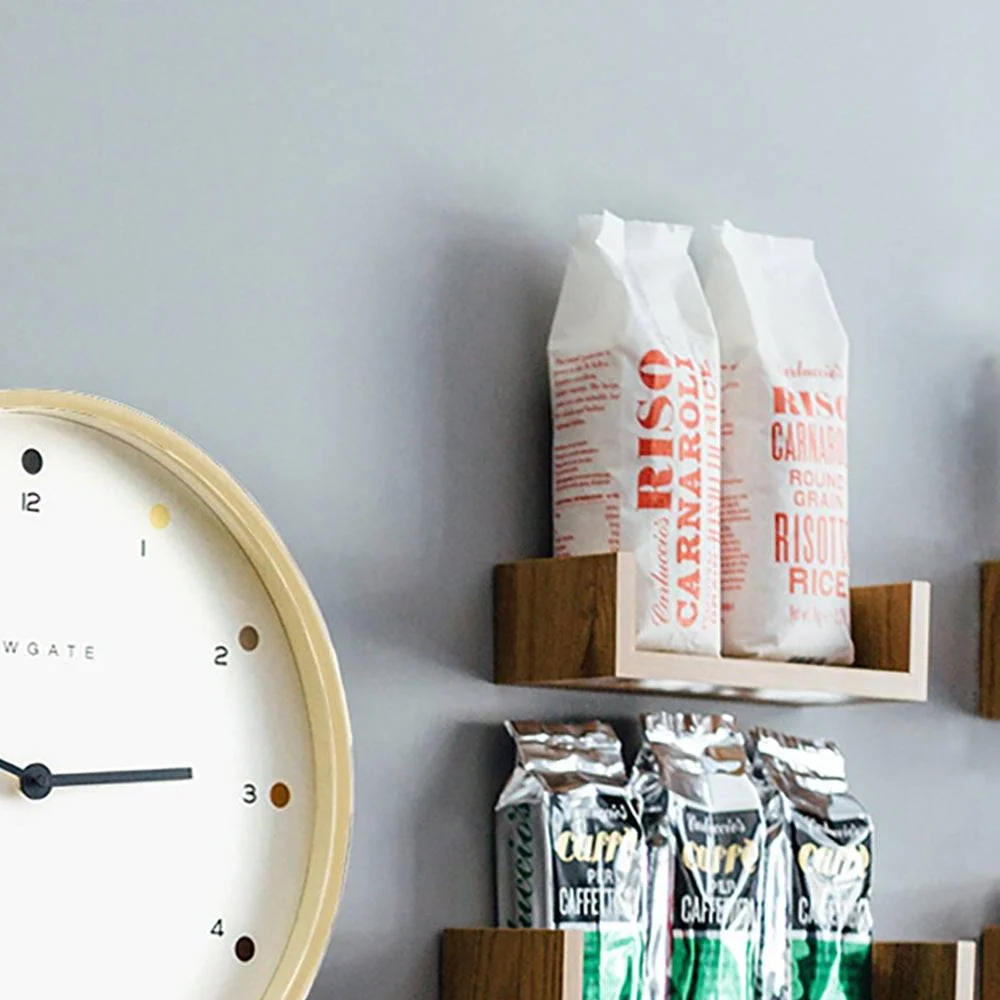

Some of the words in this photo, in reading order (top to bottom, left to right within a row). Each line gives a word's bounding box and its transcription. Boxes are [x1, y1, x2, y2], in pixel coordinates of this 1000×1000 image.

[636, 348, 674, 510] RISO
[22, 491, 41, 513] 12
[675, 354, 702, 629] CARNAROLI
[140, 539, 147, 557] 1
[649, 517, 670, 627] Carluccio's
[788, 567, 848, 599] RICE
[213, 646, 229, 667] 2
[242, 783, 258, 805] 3
[209, 918, 226, 938] 4
